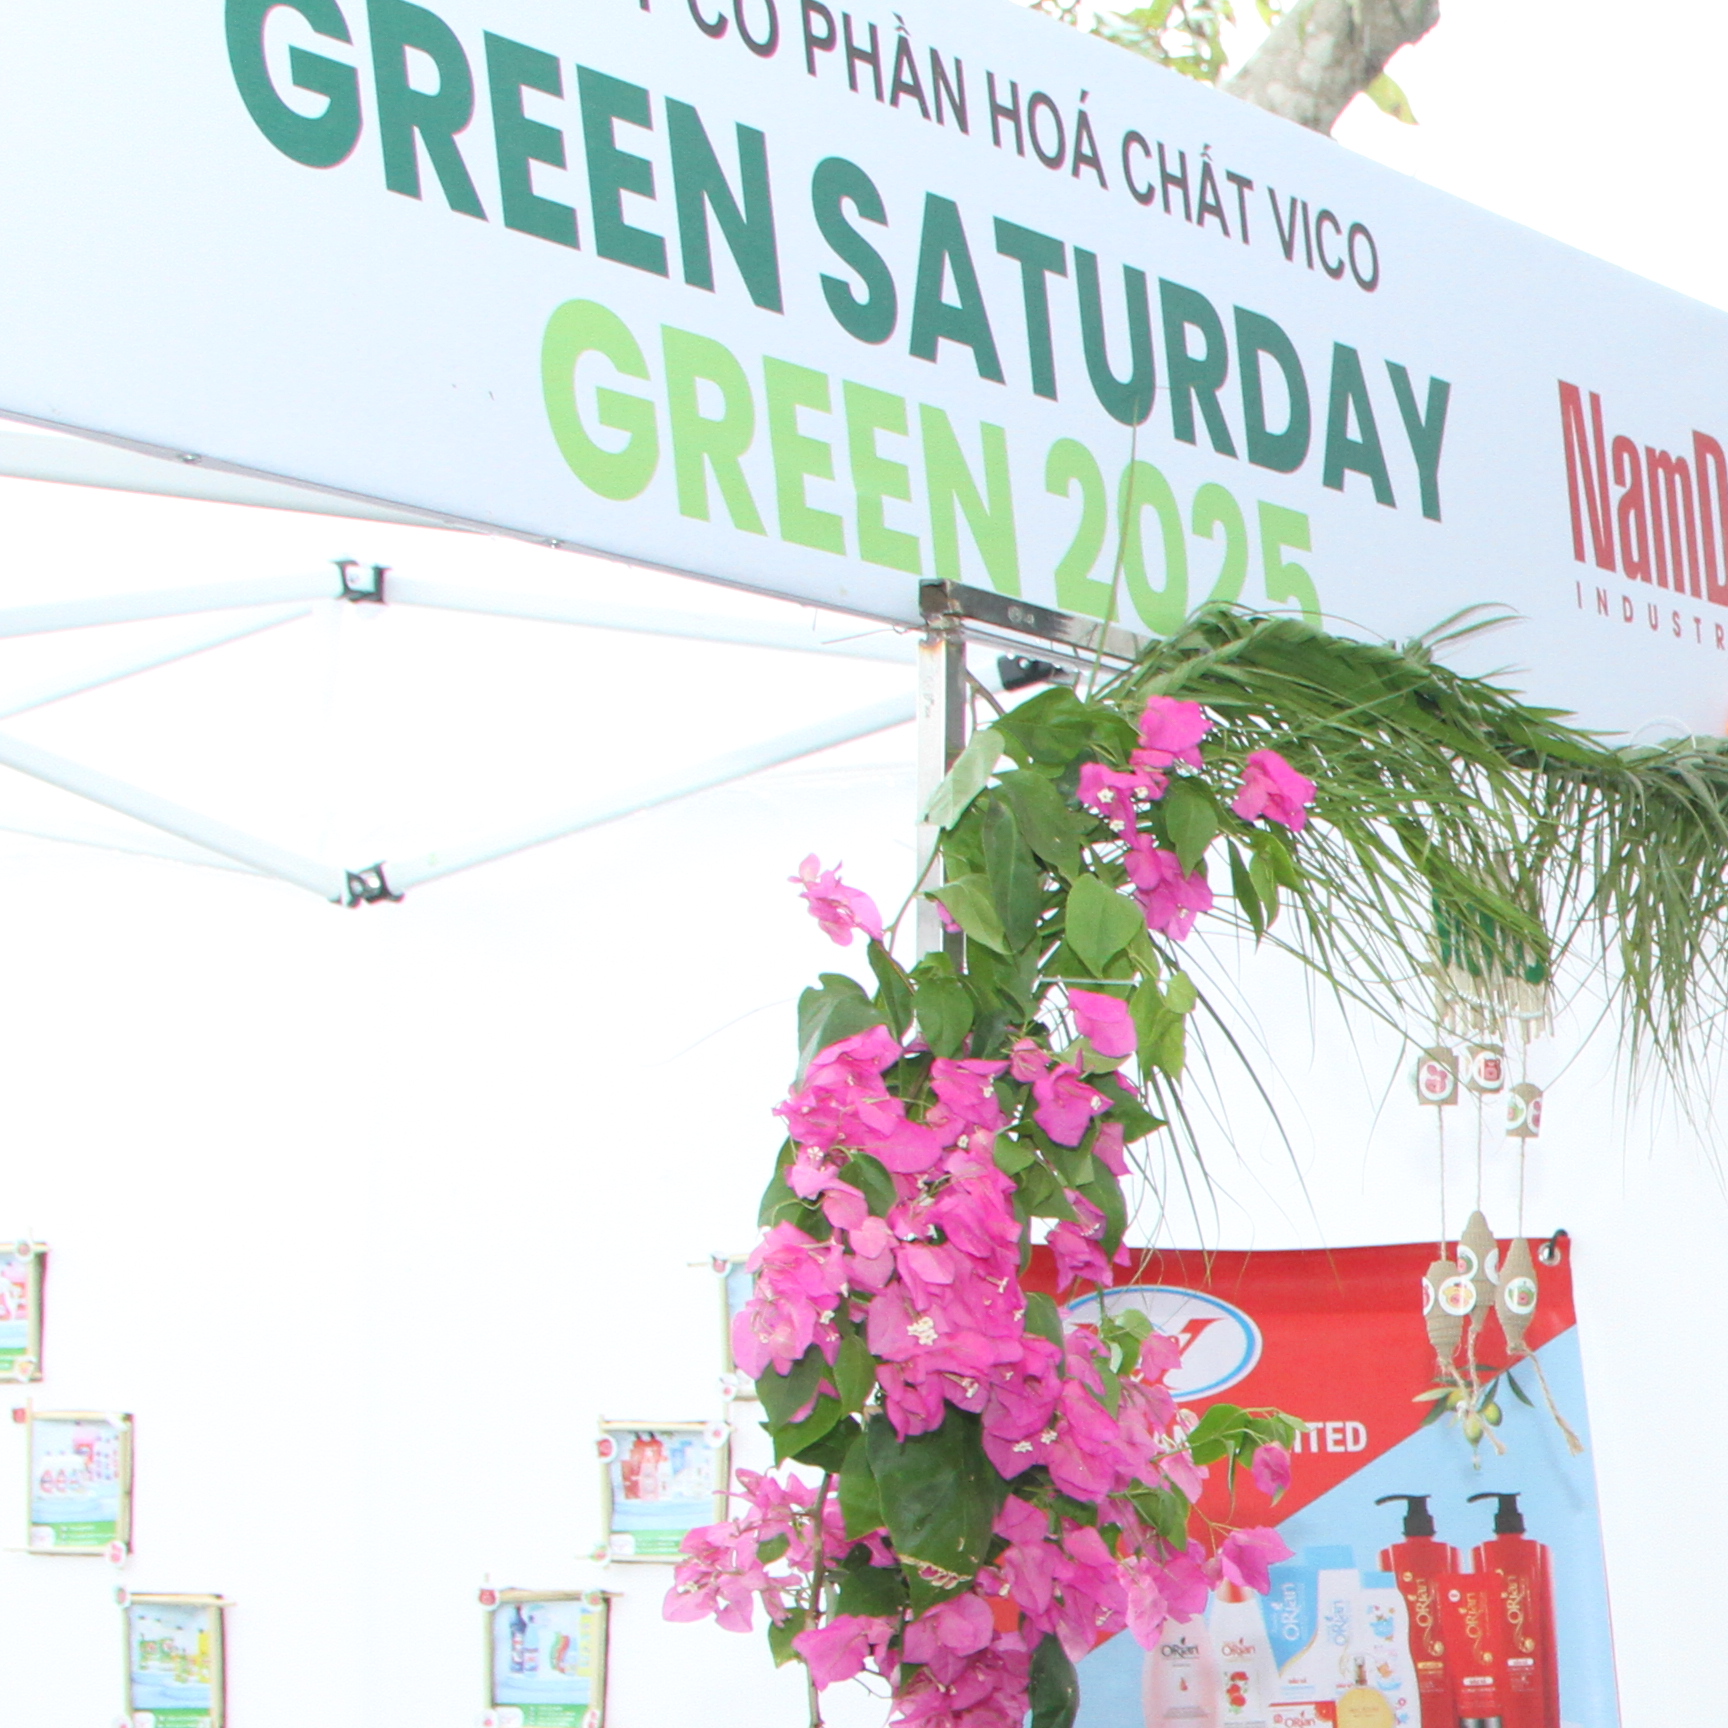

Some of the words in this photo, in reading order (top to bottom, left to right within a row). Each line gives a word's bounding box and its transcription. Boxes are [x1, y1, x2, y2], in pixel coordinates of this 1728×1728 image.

[225, 0, 784, 316] GREEN
[810, 155, 1452, 524] SATURDAY
[800, 0, 969, 137] PHẦN
[986, 70, 1108, 191] HOÁ
[1122, 129, 1254, 245] CHẤT
[1266, 186, 1381, 293] VICO
[541, 298, 1022, 600] GREEN
[1044, 436, 1323, 637] 2025
